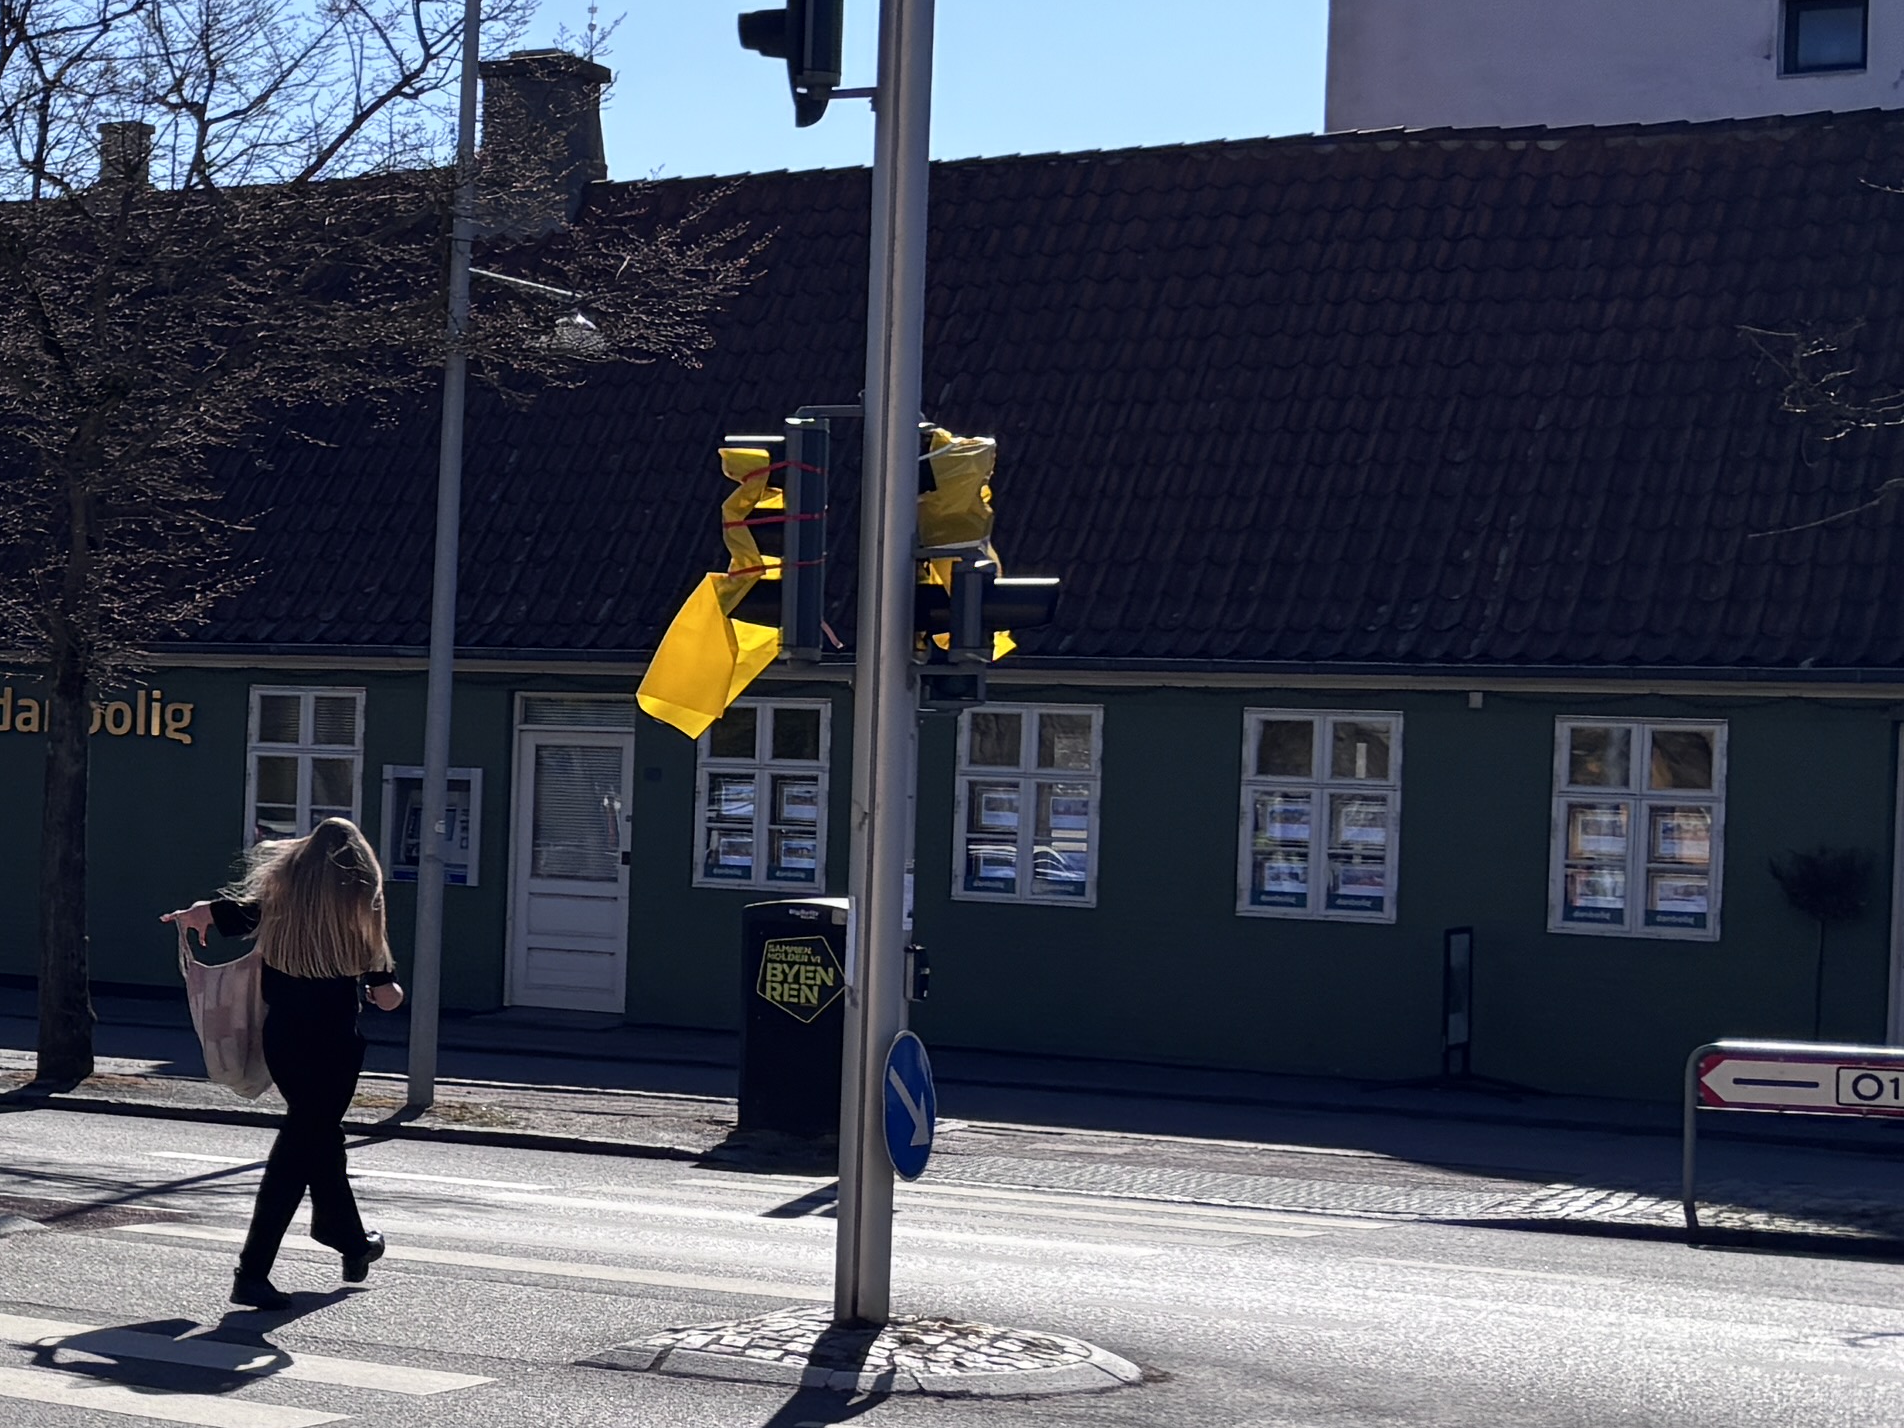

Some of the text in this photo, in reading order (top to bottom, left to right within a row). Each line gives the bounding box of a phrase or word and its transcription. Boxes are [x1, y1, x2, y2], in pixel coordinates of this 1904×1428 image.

[766, 952, 821, 963] HOLDER VI
[767, 944, 812, 954] SAMMEN
[766, 962, 834, 986] BYEN
[765, 982, 819, 1005] REN
